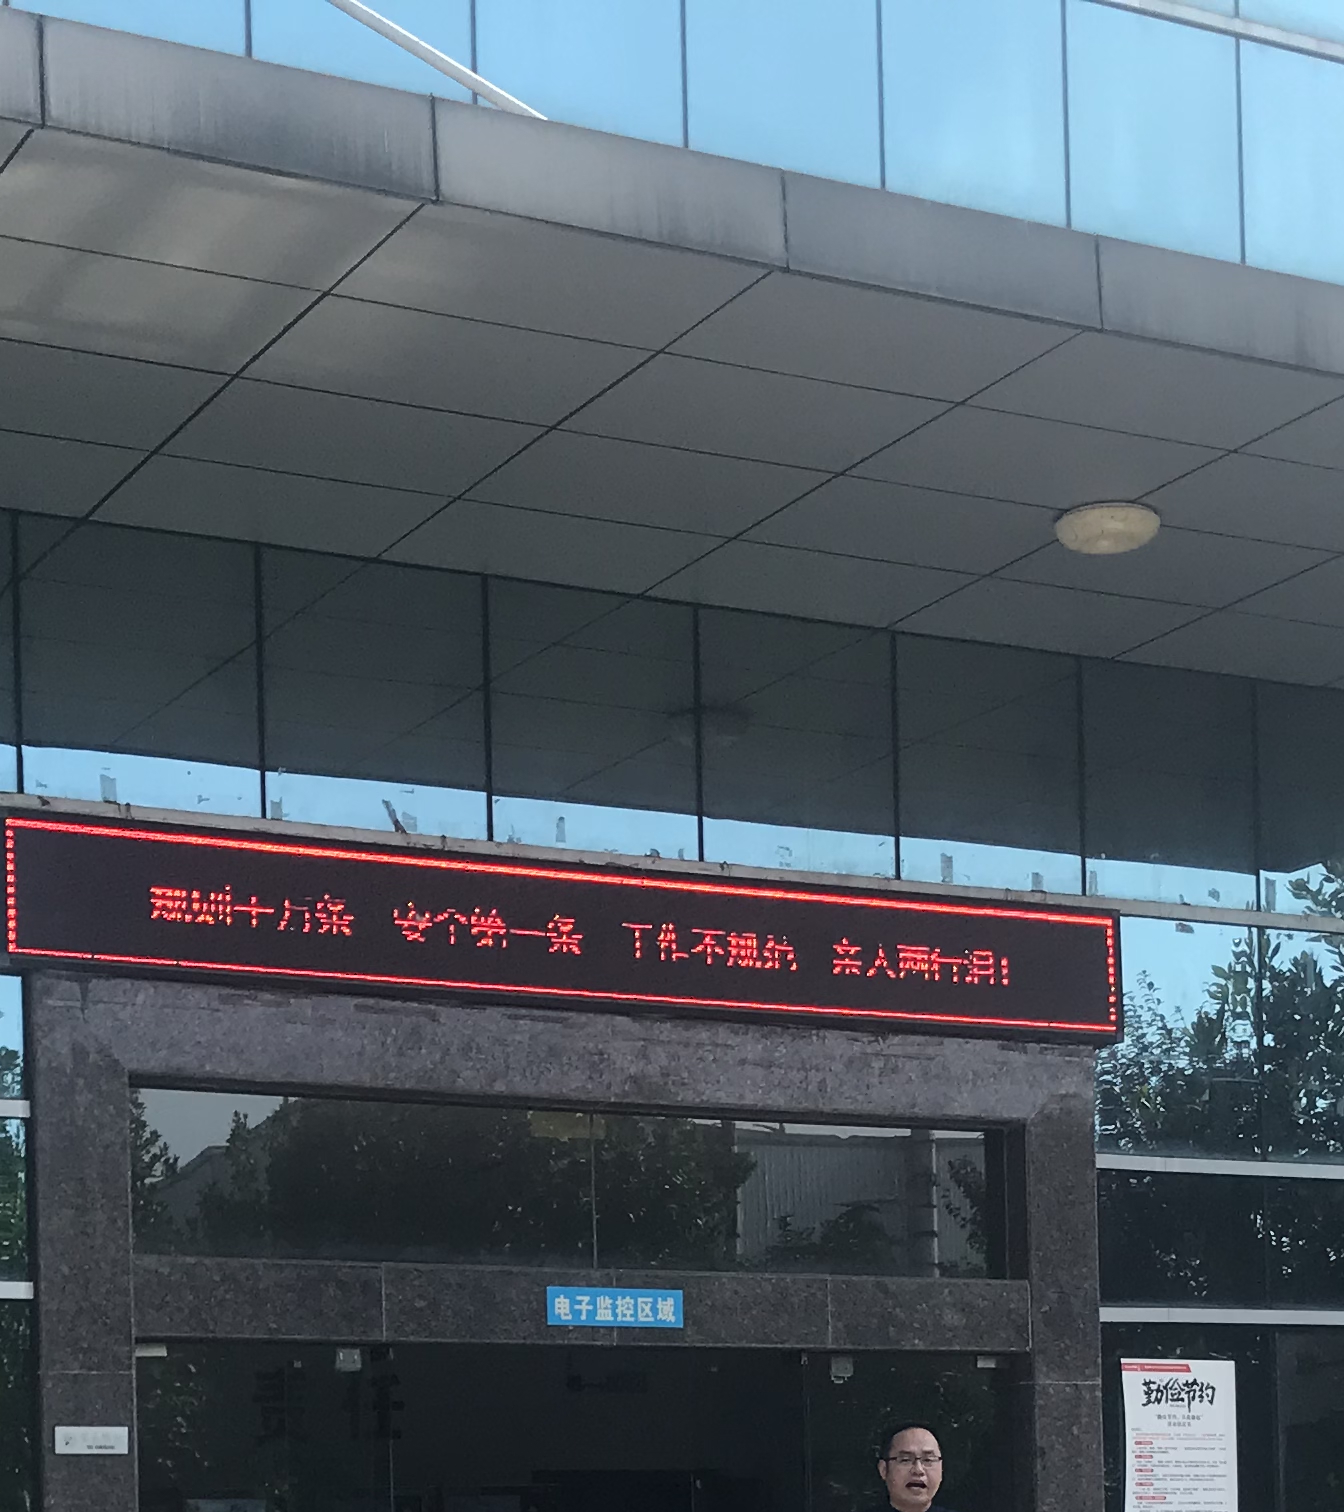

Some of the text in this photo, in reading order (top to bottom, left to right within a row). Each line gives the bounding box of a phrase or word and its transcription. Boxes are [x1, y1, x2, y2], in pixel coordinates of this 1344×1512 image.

[553, 1293, 677, 1323] 电子监控区域
[1140, 1377, 1217, 1413] 勤俭节约
